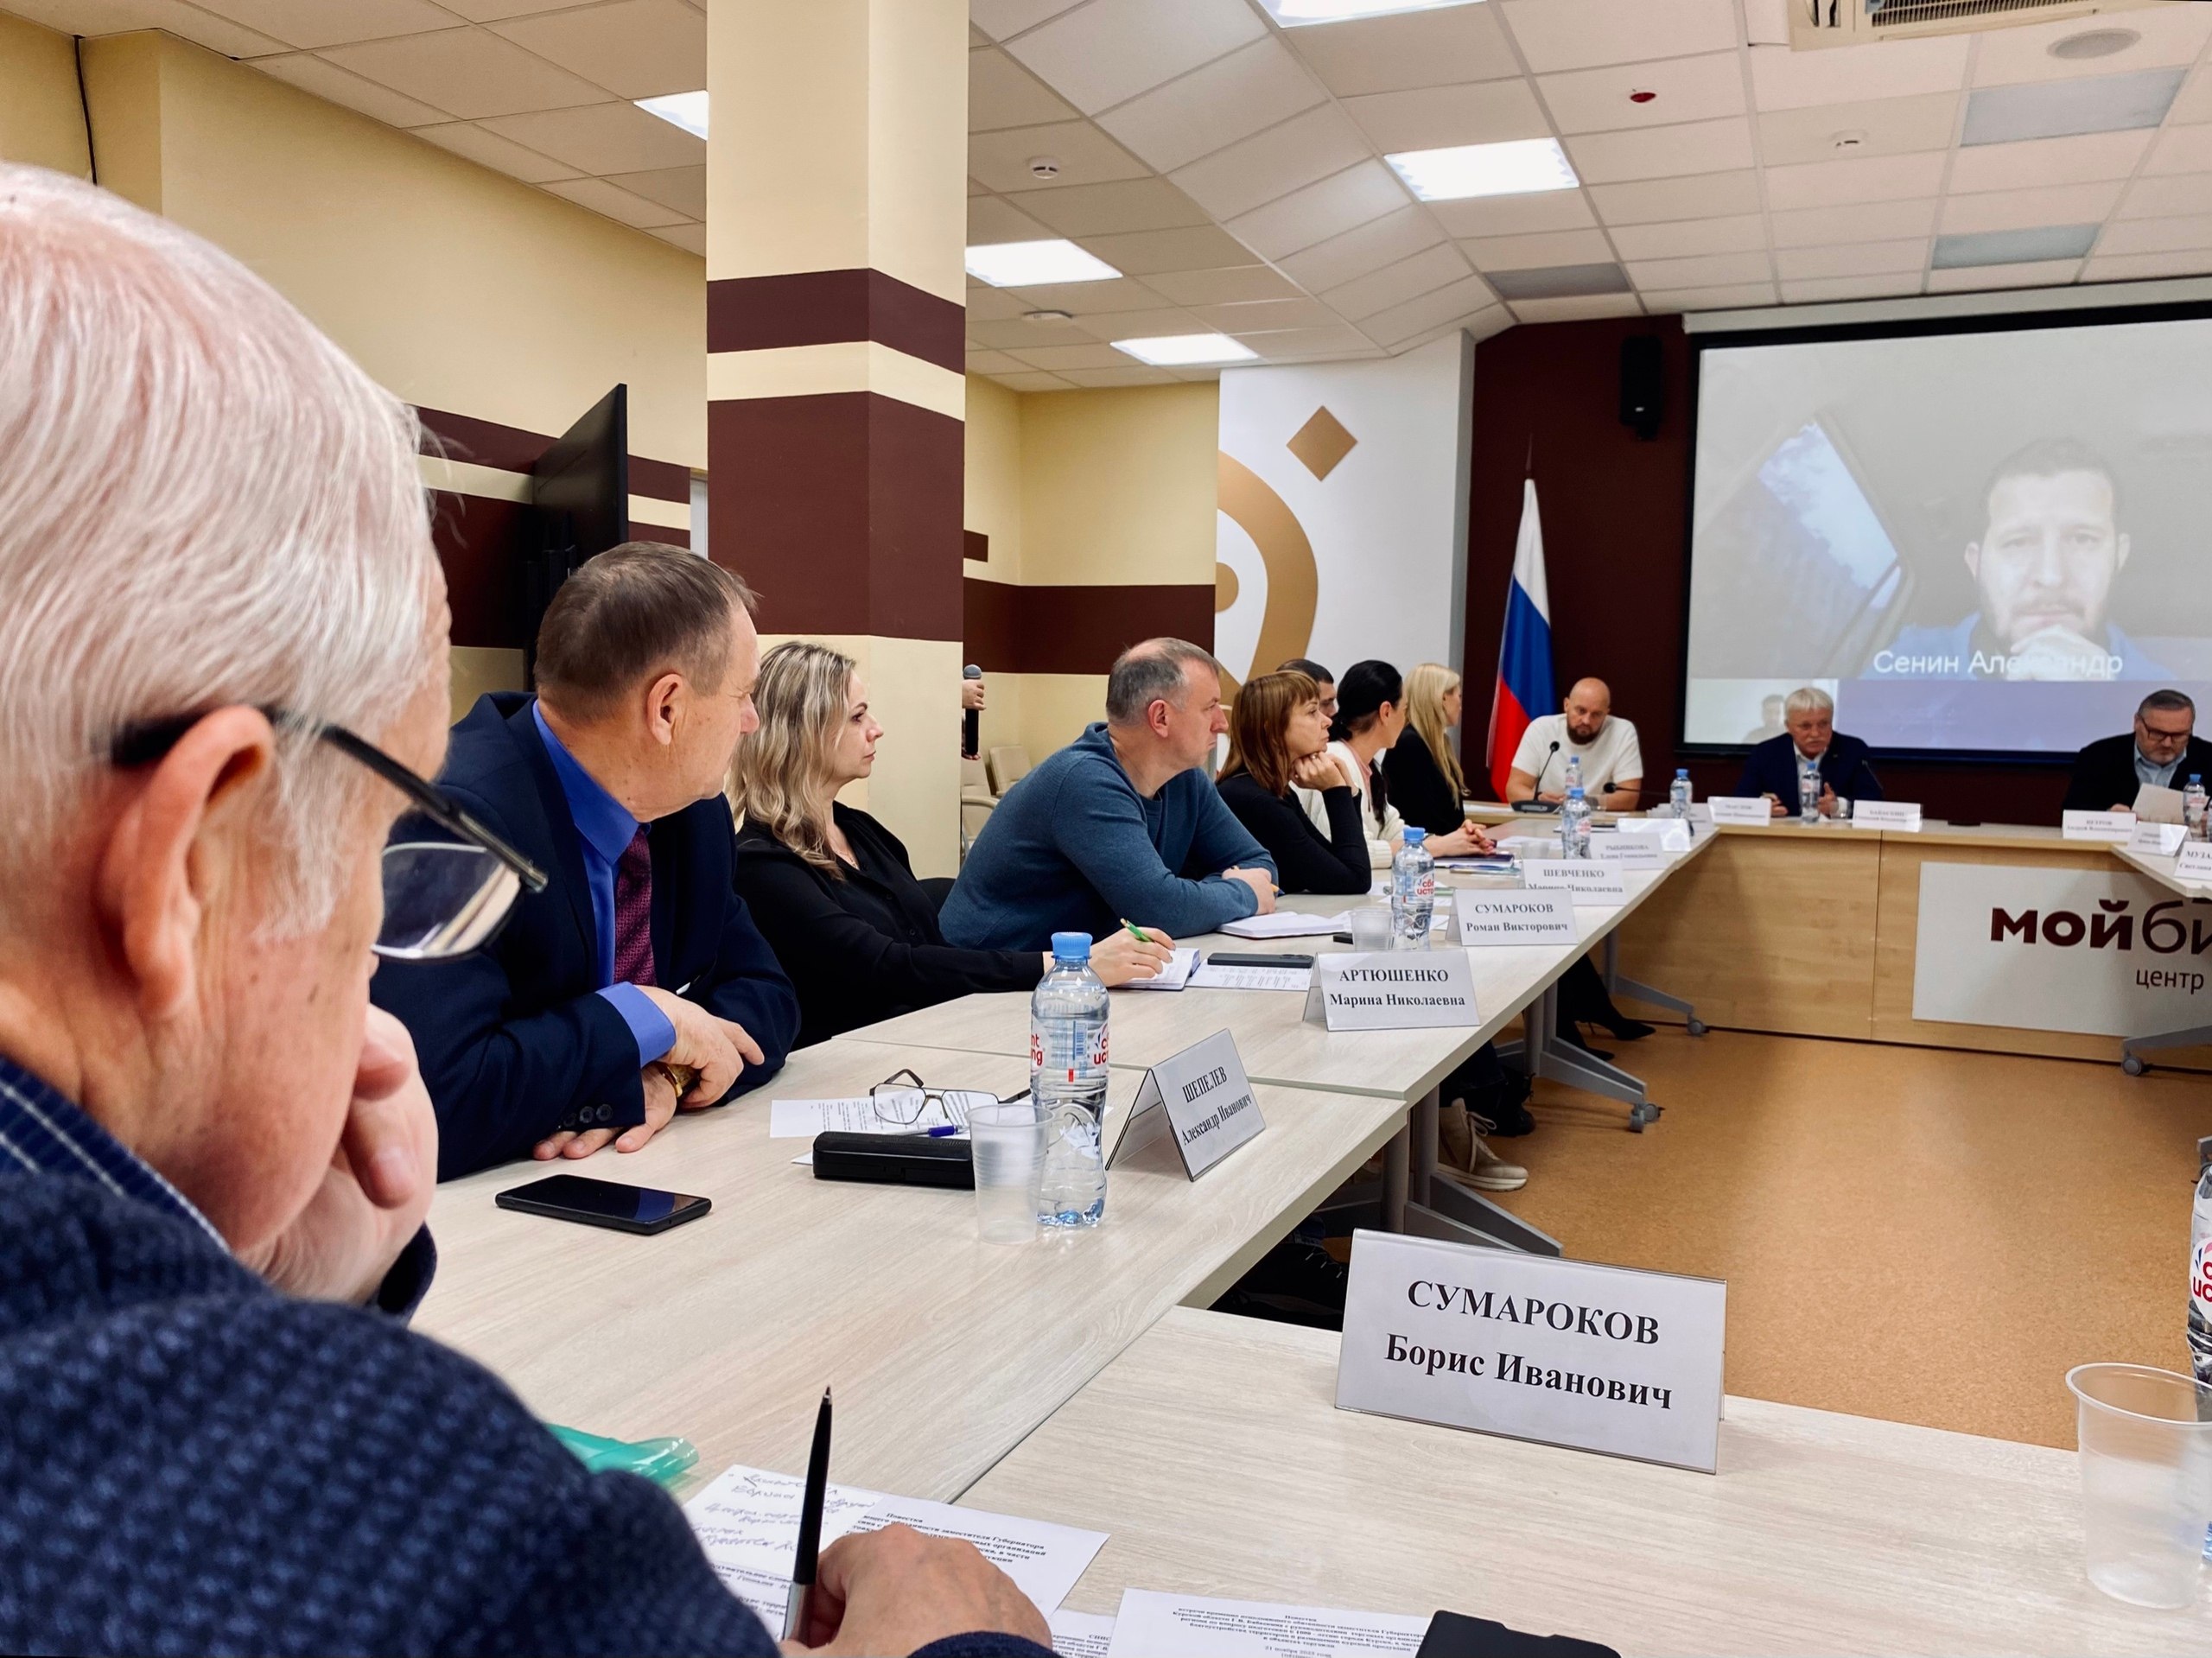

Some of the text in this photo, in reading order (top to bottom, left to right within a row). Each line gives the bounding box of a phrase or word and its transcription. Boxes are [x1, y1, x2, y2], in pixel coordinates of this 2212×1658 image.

[1873, 651, 1959, 673] Сенин
[1543, 869, 1605, 878] ШЕВЧЕНКО
[1475, 905, 1554, 913] СУМАРОКОВ
[1466, 921, 1568, 932] Роман Викторович
[1339, 969, 1449, 981] АРТЮШЕНКО
[2136, 968, 2204, 994] центр
[1330, 994, 1465, 1007] Марина Николаевна
[1182, 1066, 1228, 1103] ШЕПЕЛЕВ
[1181, 1094, 1252, 1146] Александр Иванович
[1408, 1280, 1660, 1345] СУМАРОКОВ
[1384, 1333, 1673, 1411] Борис Иванович
